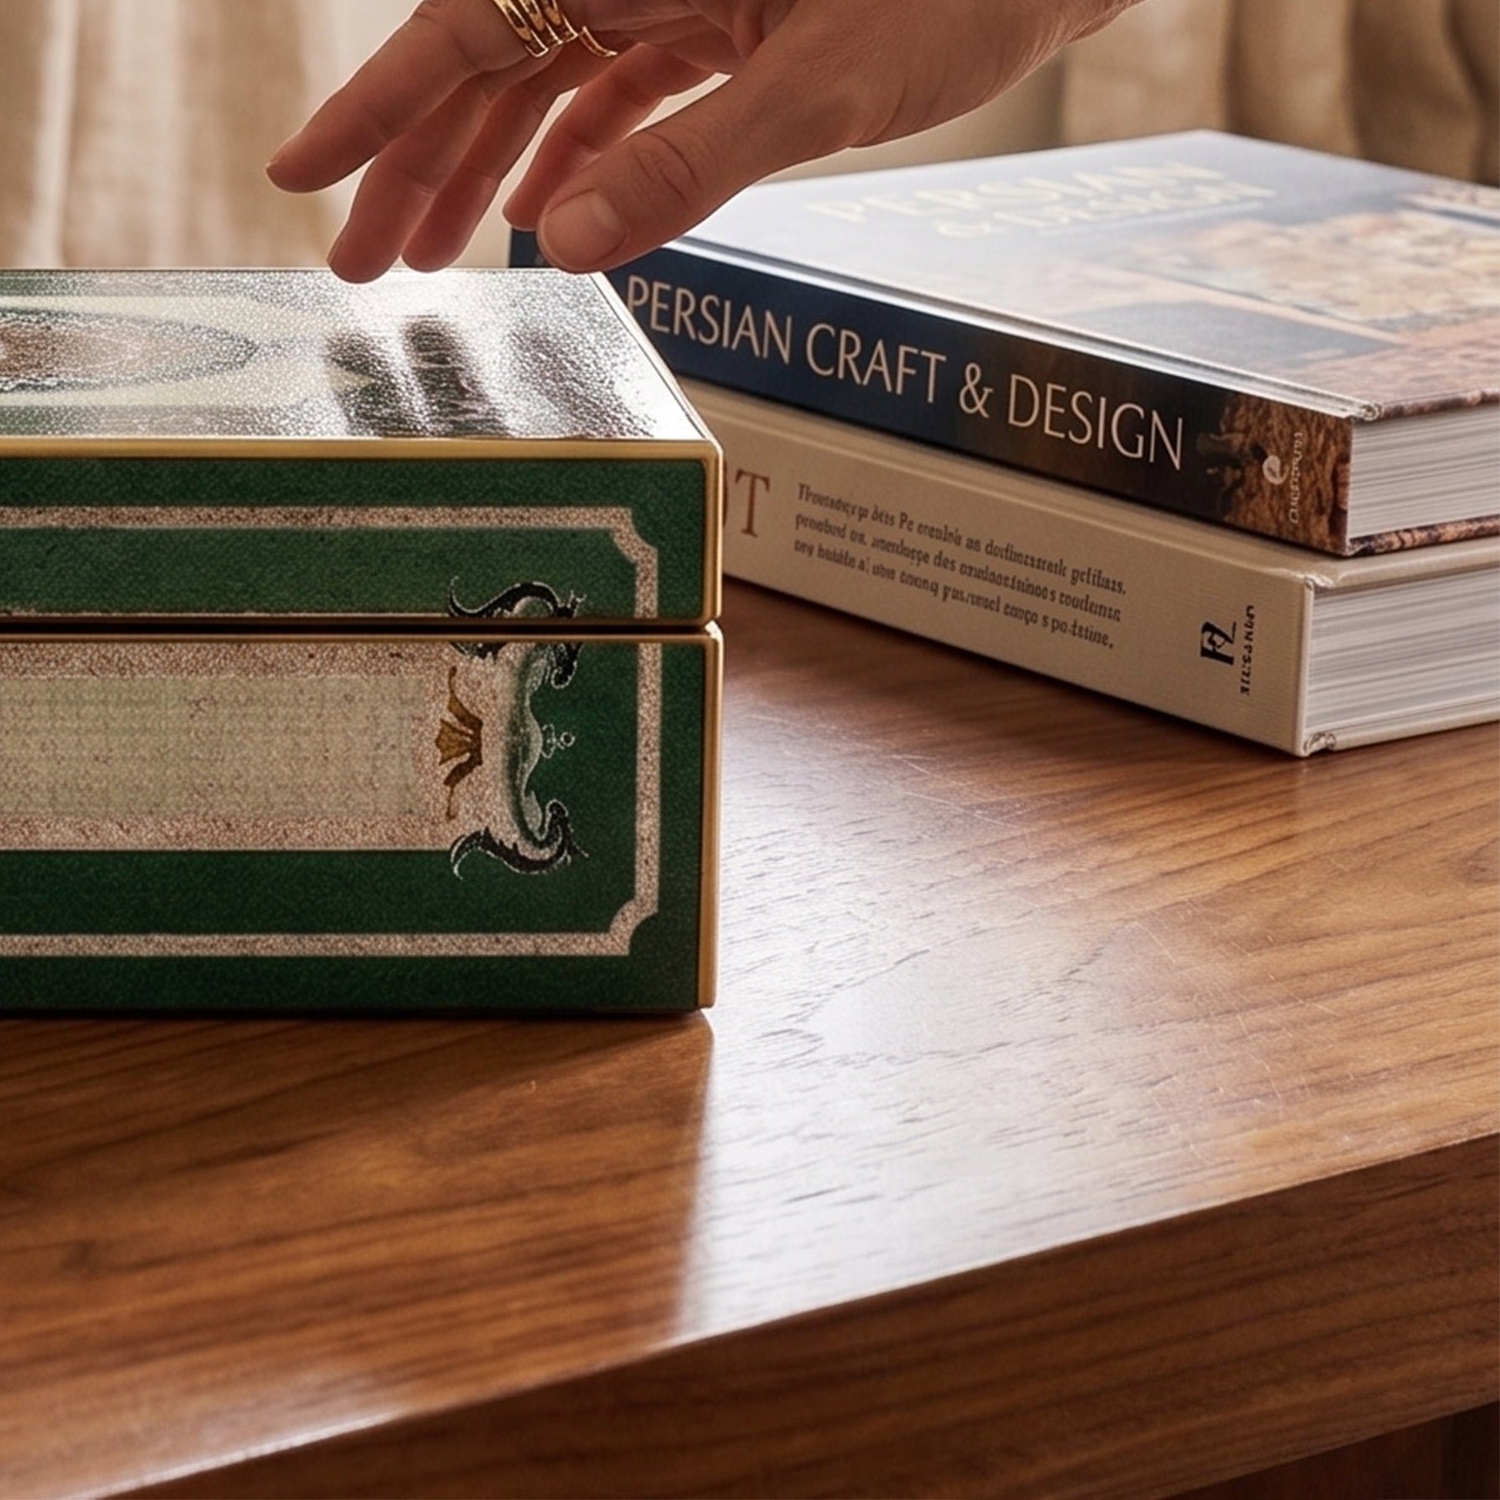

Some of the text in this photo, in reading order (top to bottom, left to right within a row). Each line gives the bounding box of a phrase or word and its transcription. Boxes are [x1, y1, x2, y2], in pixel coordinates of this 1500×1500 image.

[627, 274, 1184, 471] PERSIAN CRAFT & DESIGN
